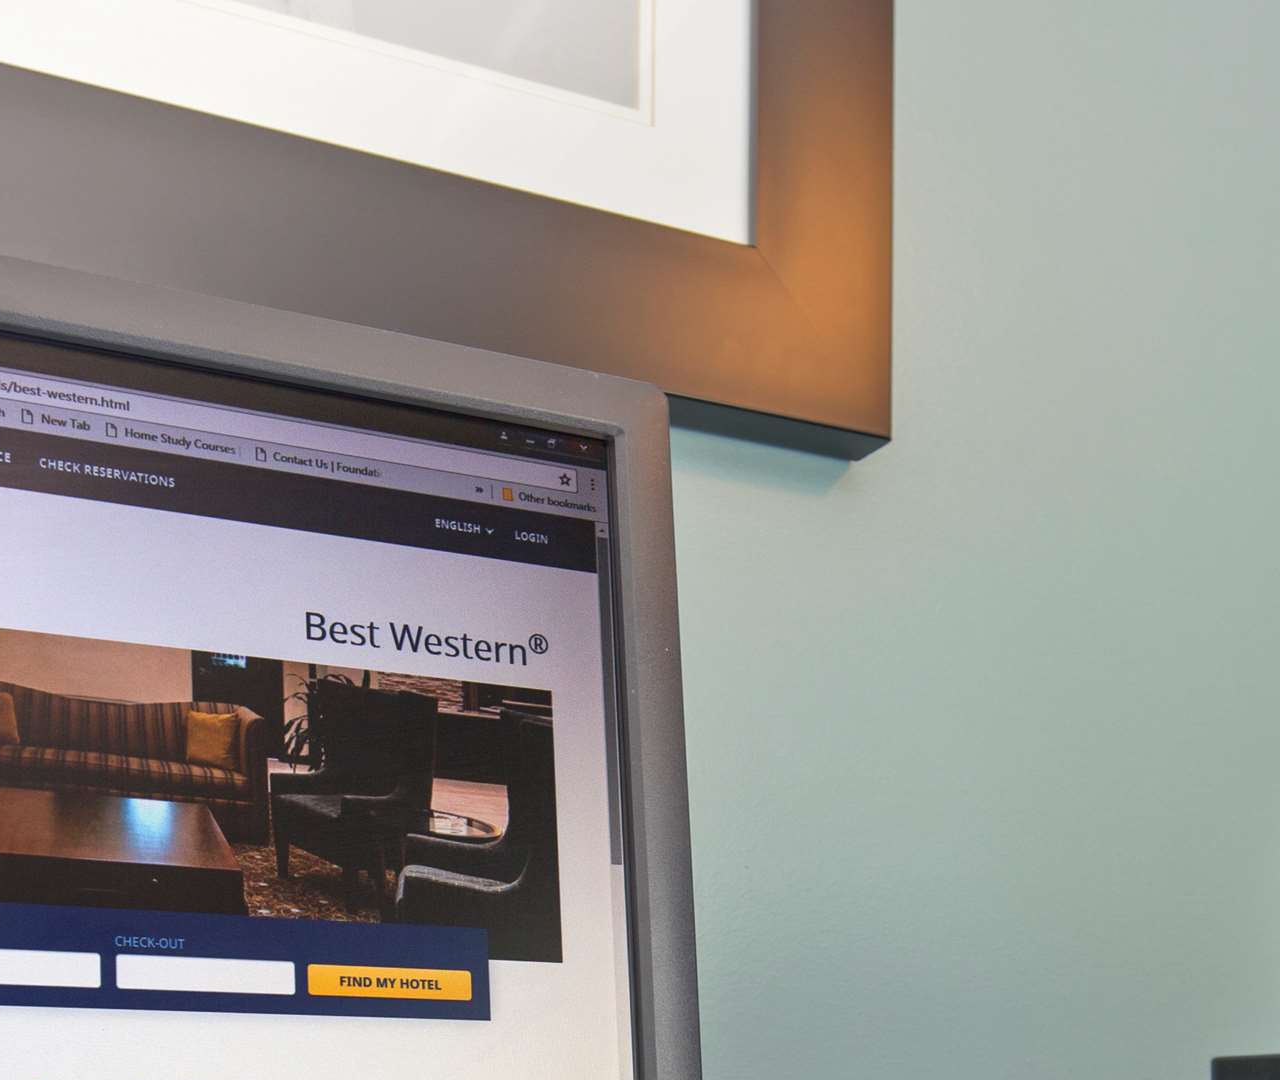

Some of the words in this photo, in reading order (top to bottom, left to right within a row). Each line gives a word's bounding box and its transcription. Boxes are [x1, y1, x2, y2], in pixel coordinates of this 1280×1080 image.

[41, 413, 67, 429] New
[70, 417, 91, 431] Tab
[124, 427, 158, 442] Home
[161, 432, 191, 450] Study
[194, 439, 236, 455] Courses
[272, 451, 313, 468] Contact
[316, 456, 329, 470] Us
[39, 457, 81, 475] CHECK
[84, 464, 176, 488] RESERVATIONS
[518, 491, 546, 506] Other
[547, 496, 597, 514] bookmarks
[434, 518, 481, 534] ENGLISH
[515, 530, 548, 545] LOGIN
[305, 611, 380, 649] Best
[115, 935, 185, 950] CHECK-OUT
[339, 975, 373, 990] FIND
[376, 977, 397, 990] MY
[400, 978, 442, 991] HOTEL
